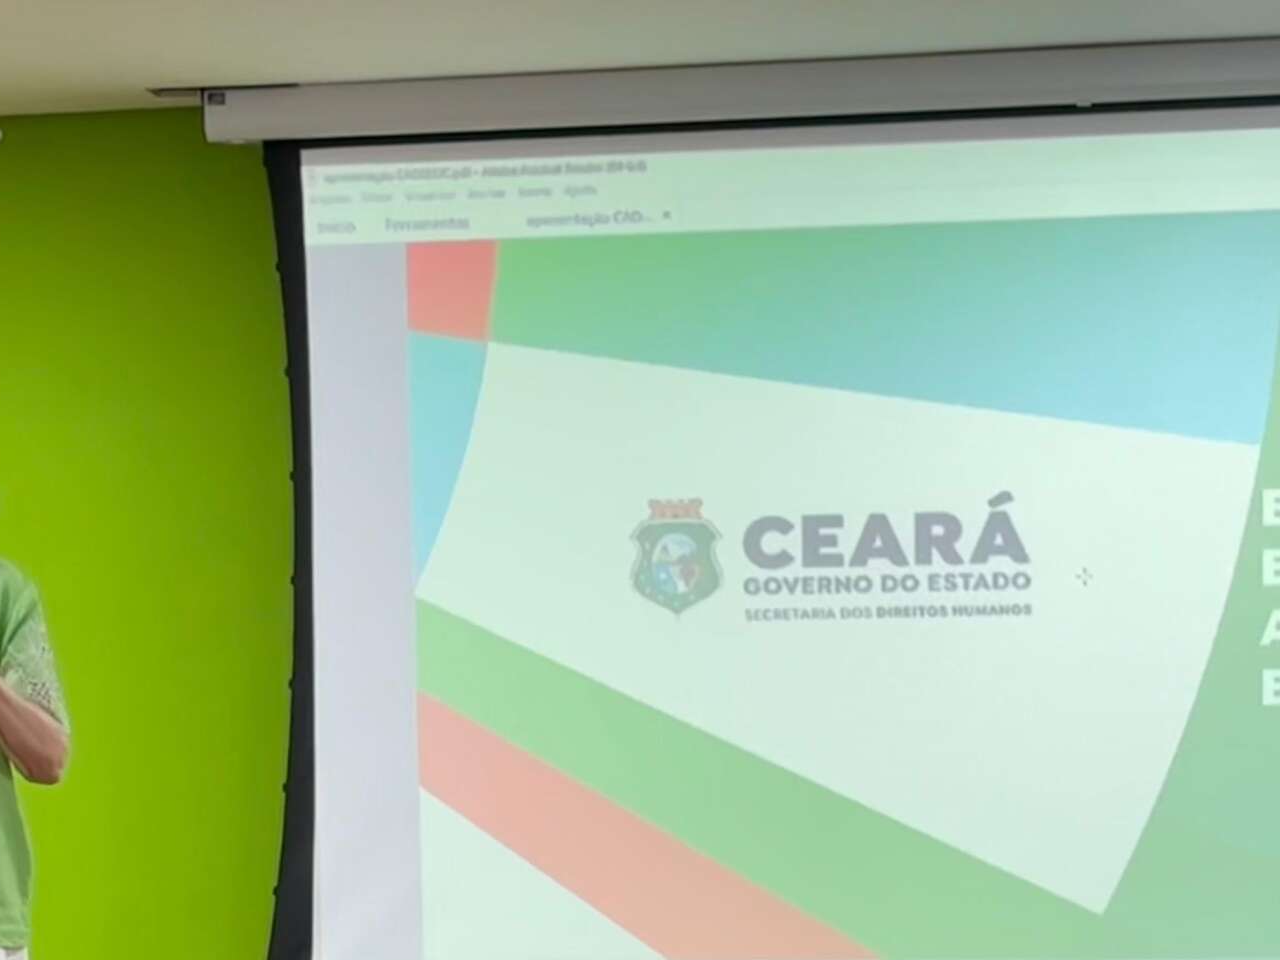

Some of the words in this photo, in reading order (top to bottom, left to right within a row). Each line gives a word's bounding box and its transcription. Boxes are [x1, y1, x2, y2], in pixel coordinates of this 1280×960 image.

[742, 490, 1031, 570] CEARÁ
[743, 575, 874, 596] GOVERNO
[880, 573, 920, 593] DO
[927, 571, 1032, 592] ESTADO
[745, 606, 837, 622] SECRETARIA
[840, 606, 873, 620] DOS
[876, 604, 948, 619] DIREITOS
[952, 602, 1033, 617] HUMANOS
